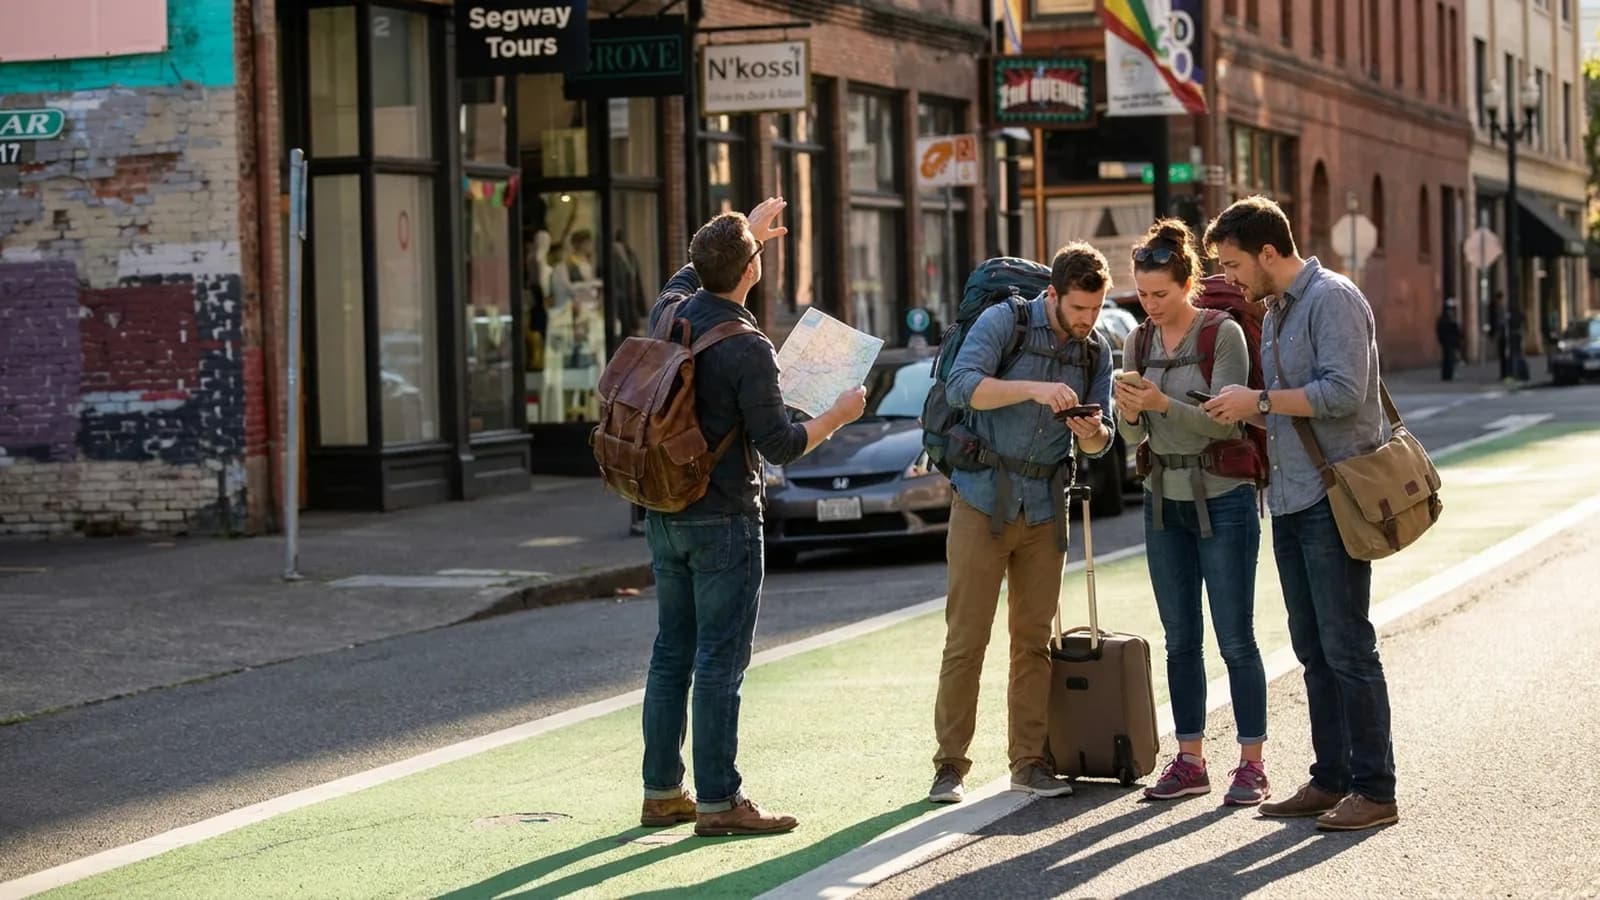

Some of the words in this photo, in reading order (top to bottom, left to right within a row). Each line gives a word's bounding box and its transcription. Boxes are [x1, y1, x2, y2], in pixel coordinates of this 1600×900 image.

[469, 6, 572, 32] Segway
[485, 36, 558, 58] Tours
[708, 46, 800, 80] N'kossi
